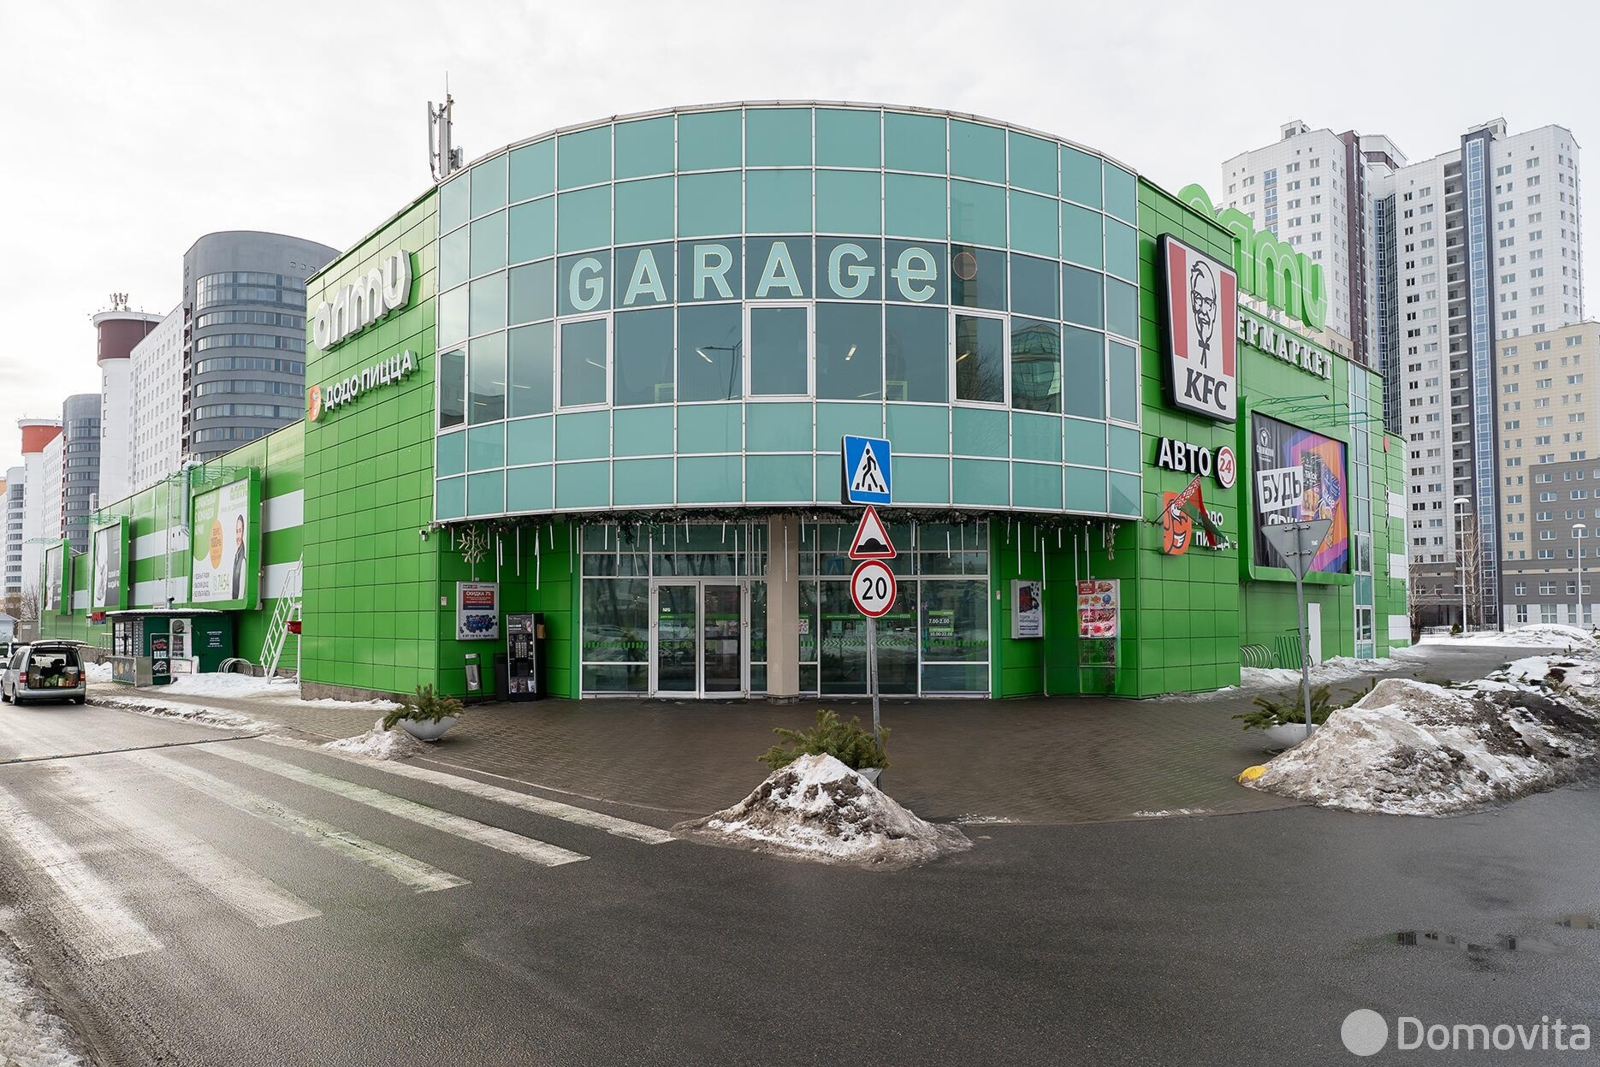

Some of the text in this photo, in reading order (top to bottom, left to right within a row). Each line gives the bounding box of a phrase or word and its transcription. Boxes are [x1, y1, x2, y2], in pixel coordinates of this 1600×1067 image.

[1238, 309, 1333, 381] ЕРМАРКЕТ
[324, 349, 412, 412] ДОДО ПИЦЦА
[1184, 366, 1228, 411] KFC
[1158, 437, 1232, 477] АВТО 24
[1261, 471, 1302, 506] БУДЬ
[862, 577, 887, 600] 20
